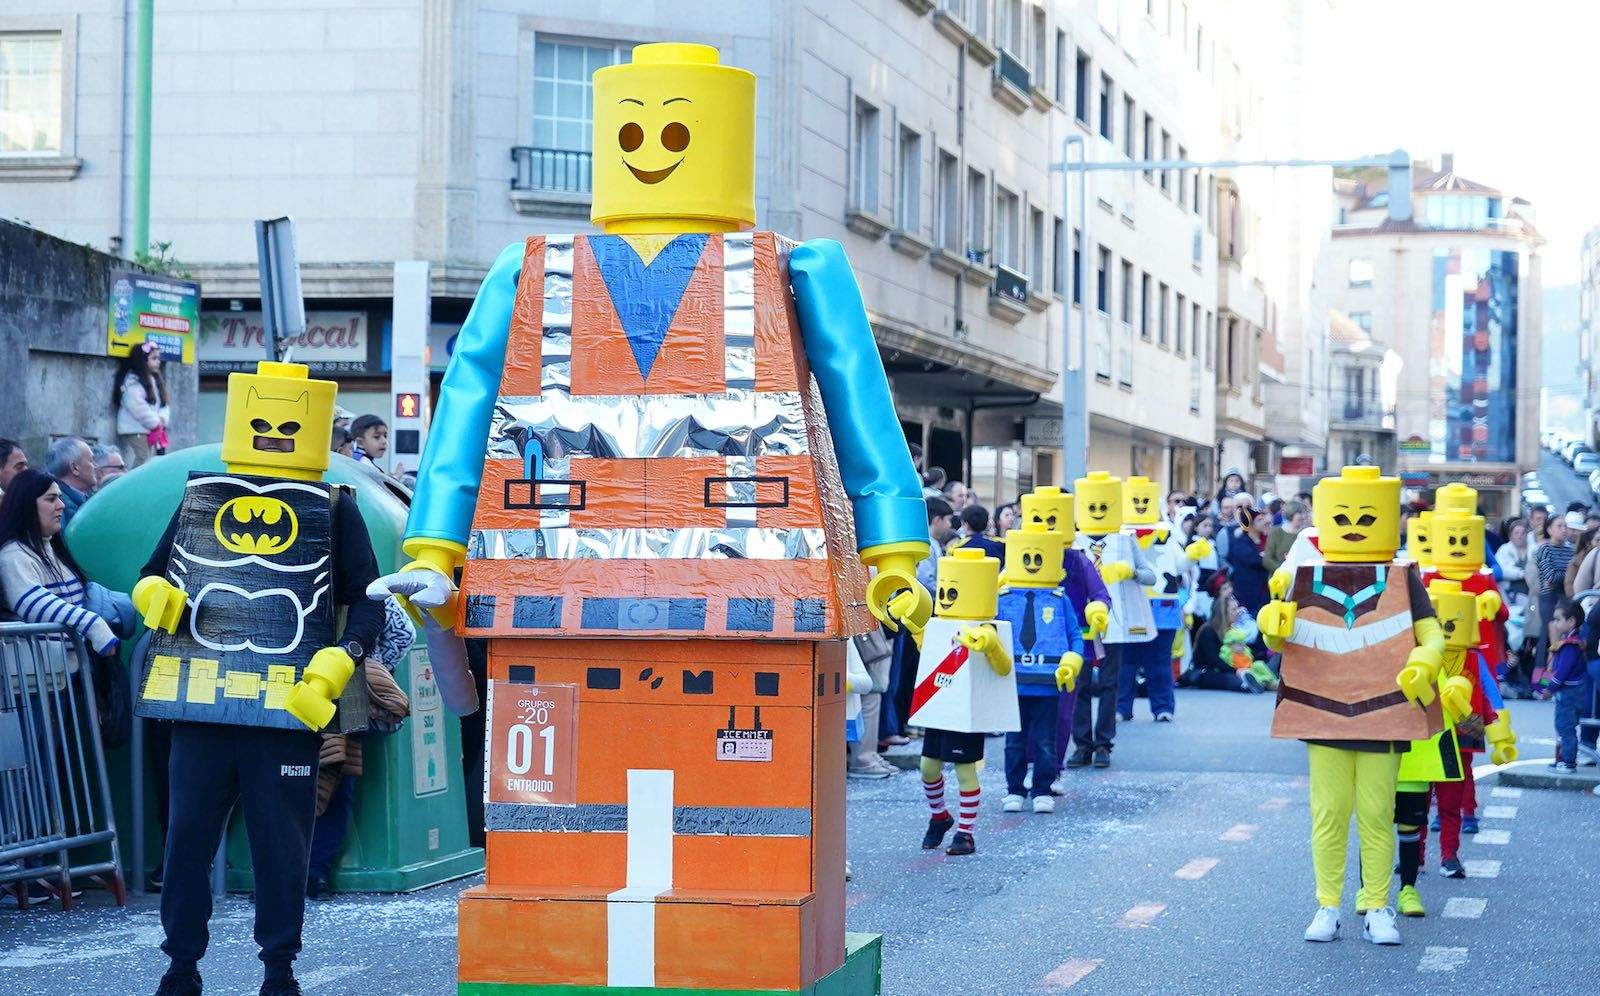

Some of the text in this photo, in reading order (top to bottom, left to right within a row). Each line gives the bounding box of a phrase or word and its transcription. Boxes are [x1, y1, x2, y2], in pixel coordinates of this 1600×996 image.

[517, 699, 555, 709] GRUPOS
[517, 708, 548, 724] -20
[507, 724, 555, 775] 01
[281, 765, 311, 776] PUMA
[507, 779, 553, 792] ENTROIDO
